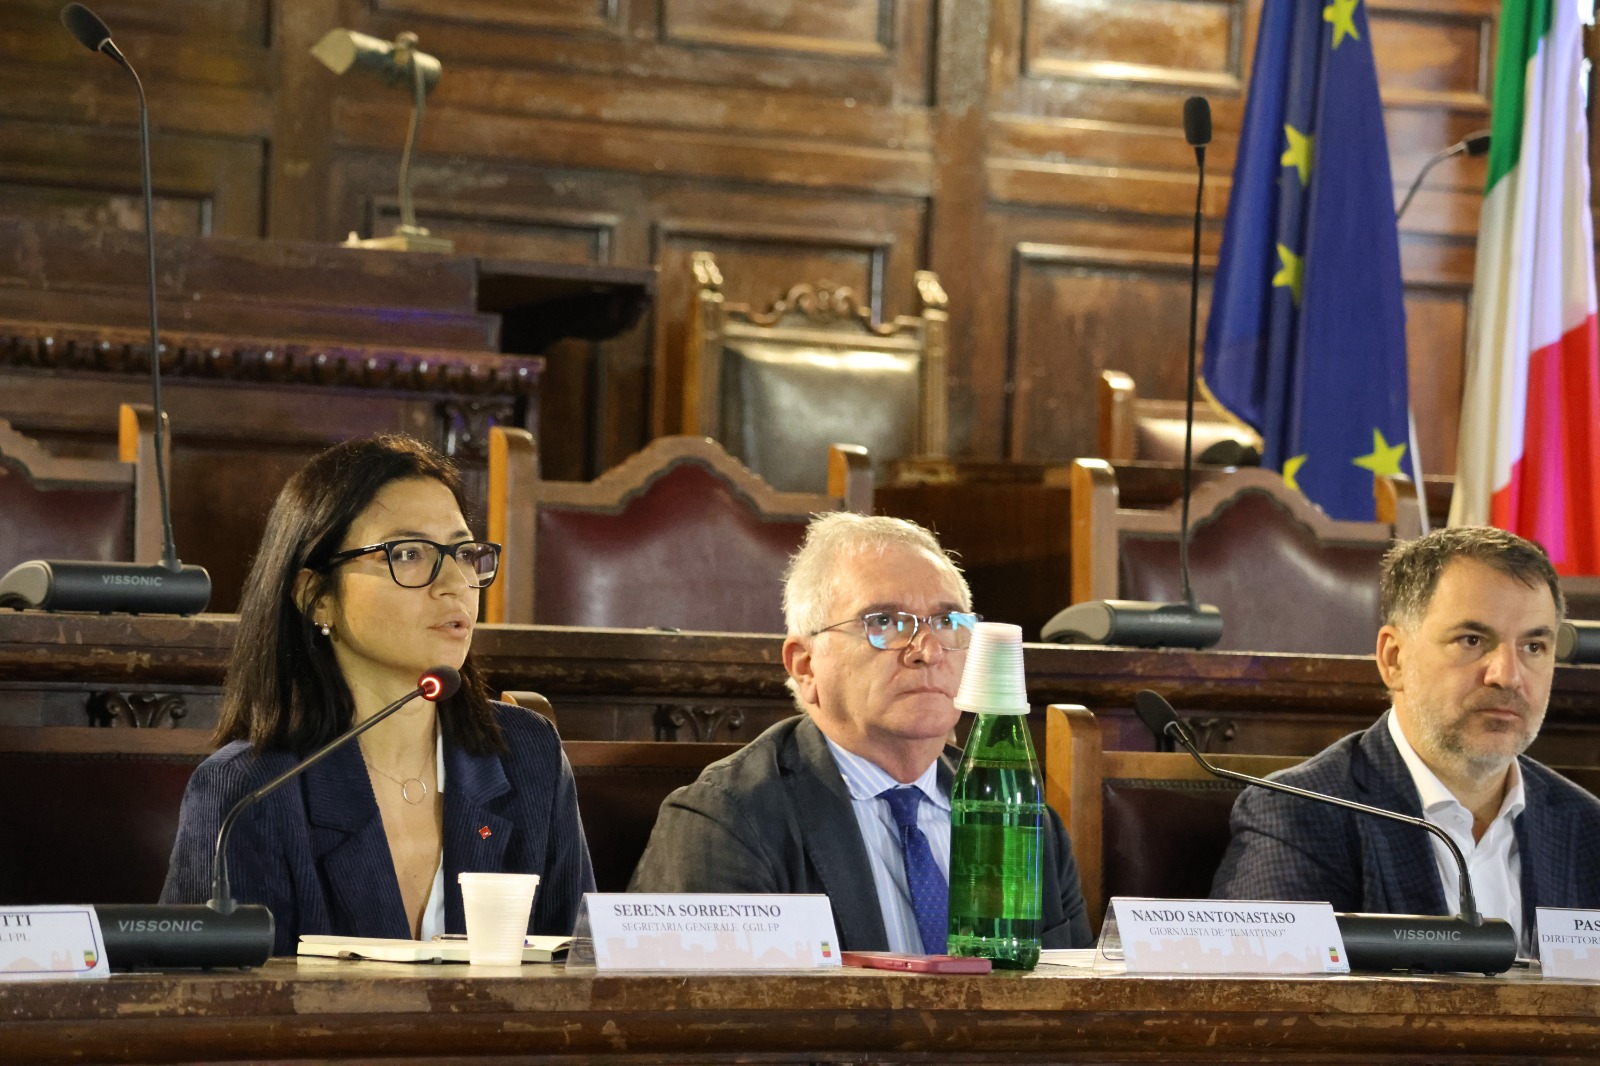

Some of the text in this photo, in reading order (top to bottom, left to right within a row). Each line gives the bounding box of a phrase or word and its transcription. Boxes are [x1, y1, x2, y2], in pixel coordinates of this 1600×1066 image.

[102, 574, 163, 586] VISSONIC
[613, 904, 781, 917] SERENA SORRENTINO
[1131, 909, 1296, 924] NANDO SANTONASTASO
[118, 920, 203, 932] VISSONIC
[621, 922, 683, 932] SEGRETARIA
[685, 922, 738, 932] GENERALE
[1149, 926, 1209, 936] GIORNALISTA
[1211, 928, 1225, 937] DE
[1393, 930, 1461, 941] VISSONIC
[1542, 934, 1600, 945] DIRETTOR
